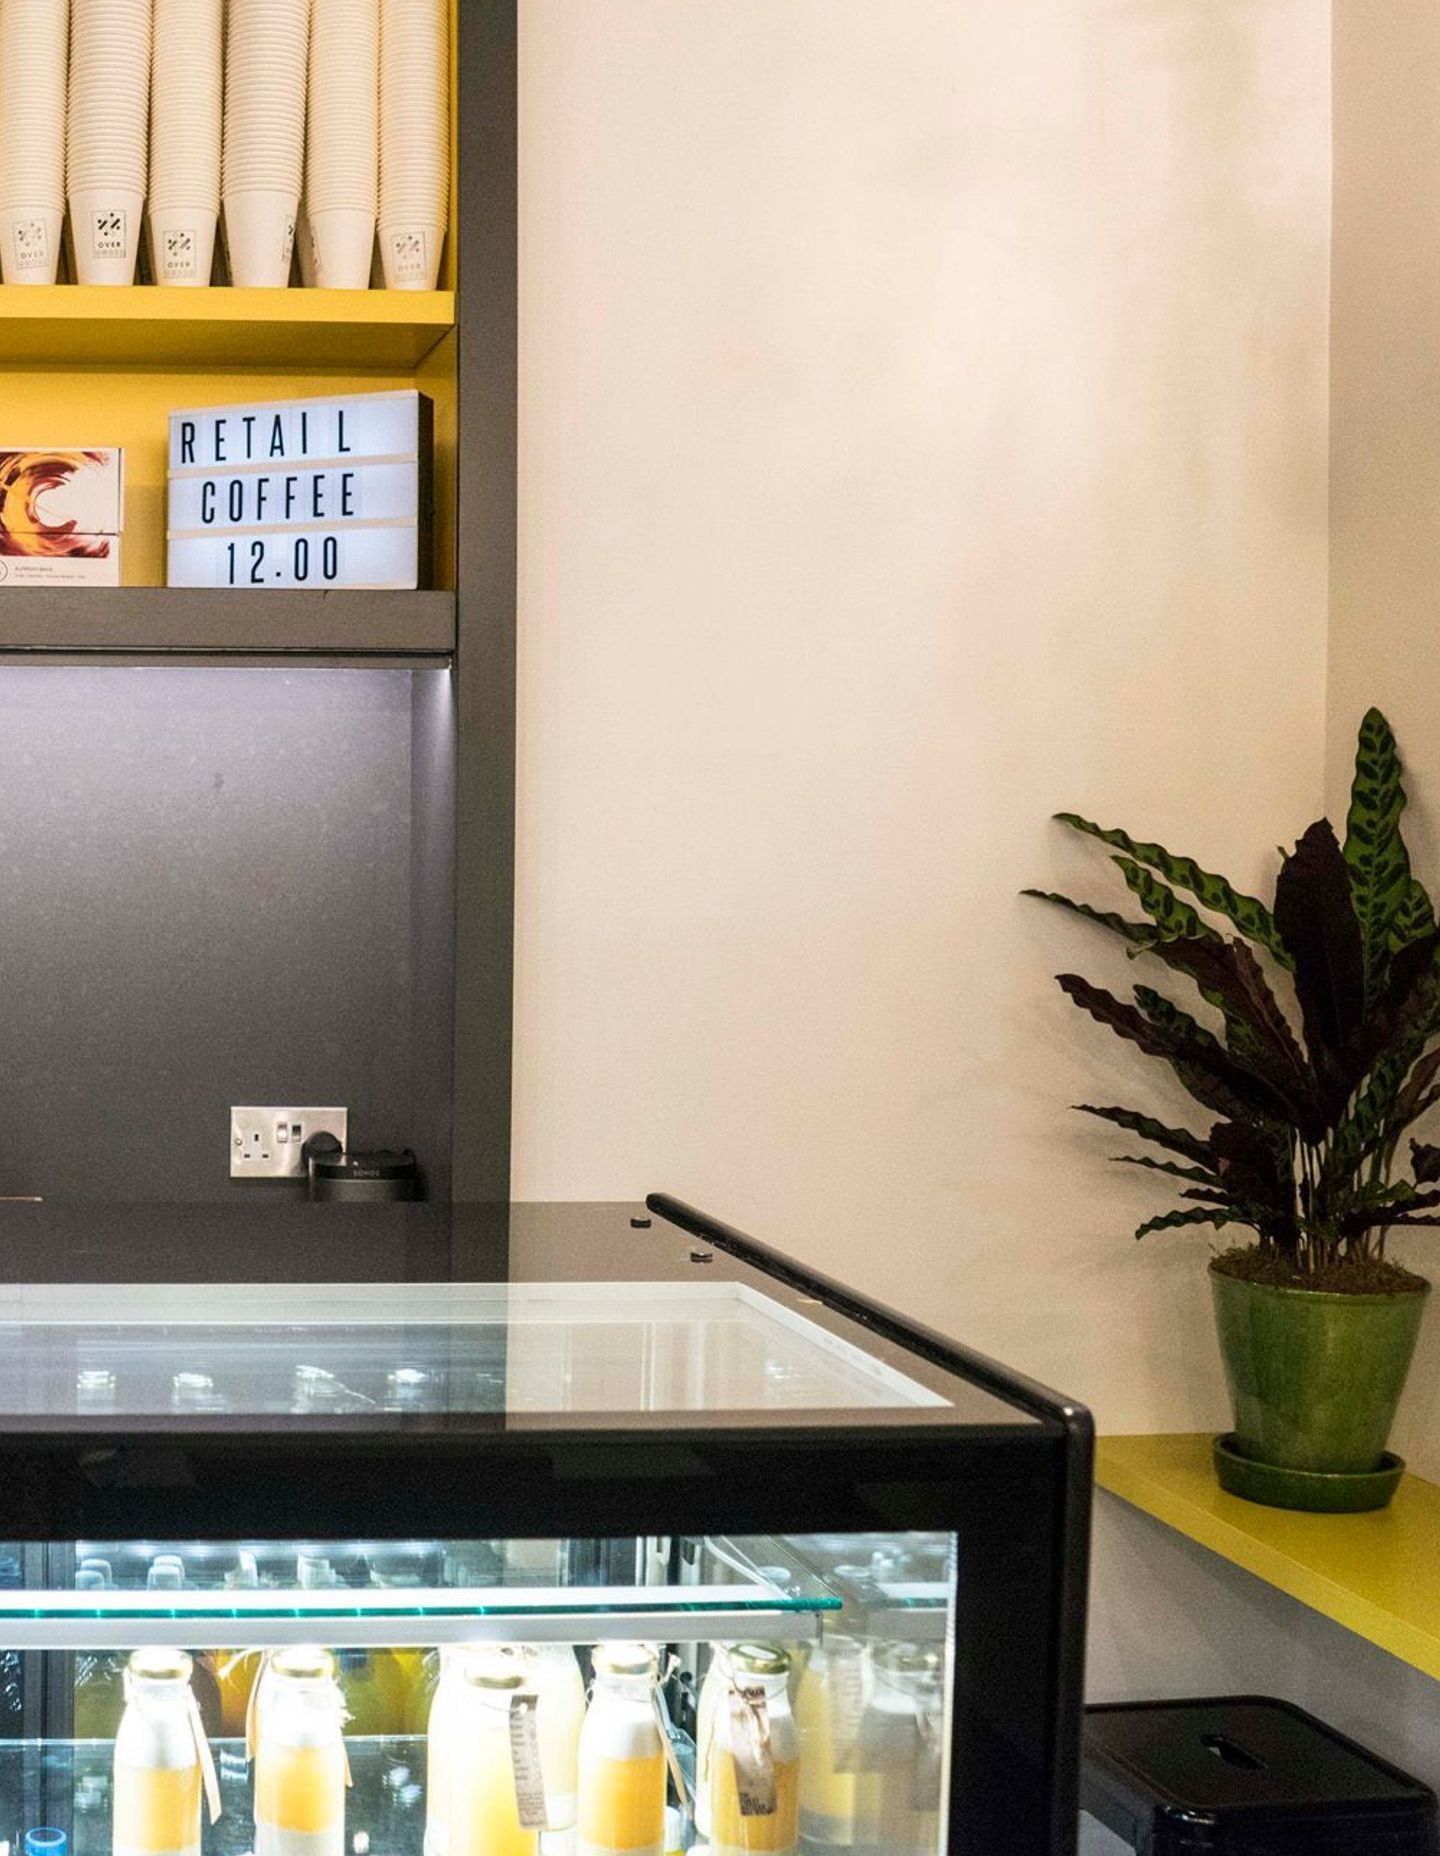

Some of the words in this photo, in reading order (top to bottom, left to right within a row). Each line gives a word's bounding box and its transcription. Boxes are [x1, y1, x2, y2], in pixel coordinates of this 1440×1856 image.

[97, 241, 121, 249] OVER
[180, 410, 351, 464] RETAIL
[201, 473, 355, 524] COFFEE
[226, 536, 338, 585] 12.00
